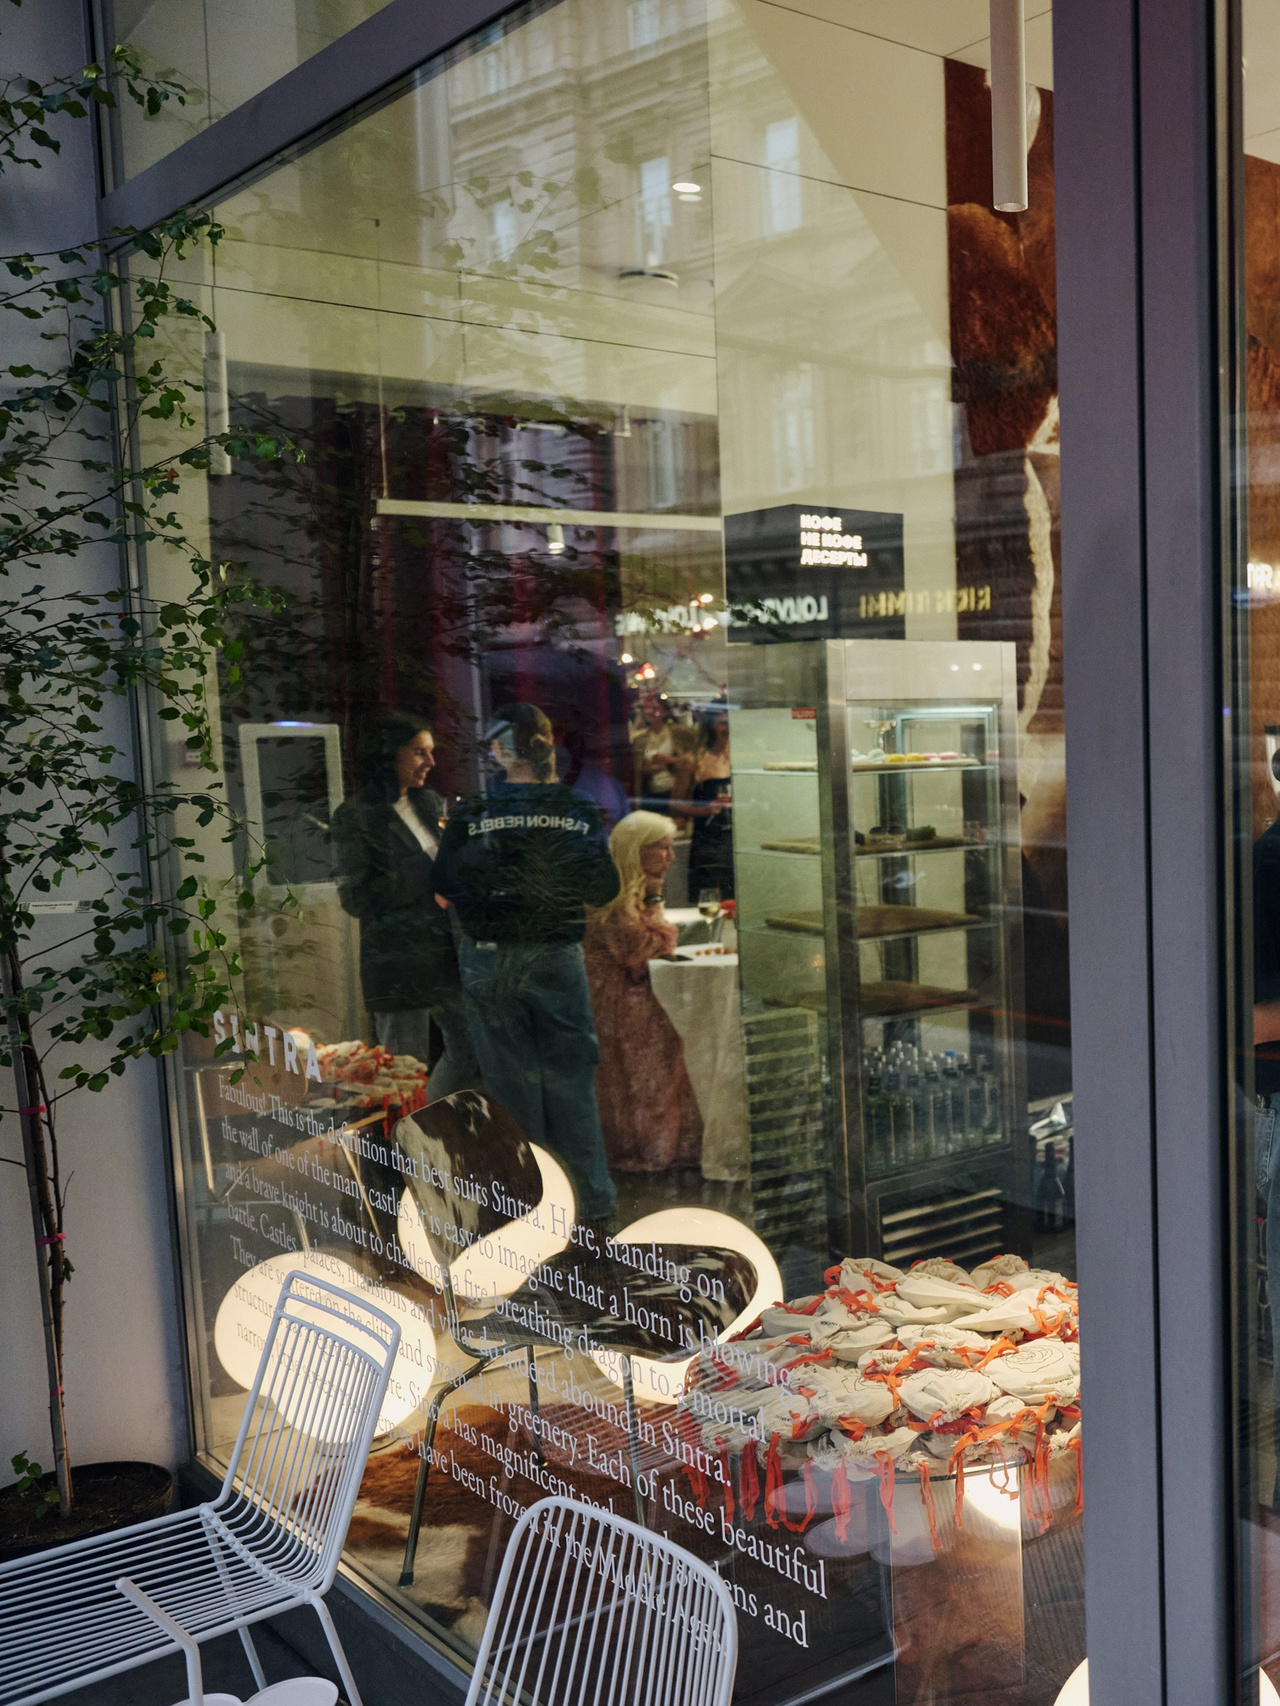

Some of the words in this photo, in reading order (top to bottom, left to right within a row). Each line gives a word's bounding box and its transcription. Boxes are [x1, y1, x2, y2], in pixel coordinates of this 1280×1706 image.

[800, 548, 867, 567] ДЕСЕРТЫ
[213, 1010, 323, 1083] SINTRA
[218, 1074, 267, 1116] Fabulous!
[268, 1093, 294, 1129] This
[295, 1110, 305, 1131] is
[306, 1112, 325, 1142] the
[327, 1117, 389, 1166] definition
[390, 1149, 418, 1177] that
[420, 1151, 450, 1192] best
[453, 1174, 488, 1207] suits
[491, 1180, 545, 1230] Sintra.
[550, 1203, 601, 1259] Here,
[605, 1236, 692, 1304] standing
[697, 1273, 727, 1306] on
[221, 1115, 238, 1144] the
[238, 1125, 259, 1154] wall
[261, 1134, 274, 1158] of
[275, 1147, 295, 1173] one
[296, 1151, 310, 1177] of
[310, 1154, 330, 1186] the
[332, 1176, 367, 1210] many
[368, 1186, 414, 1229] castles,
[416, 1201, 428, 1227] it
[429, 1208, 441, 1236] is
[444, 1223, 474, 1260] easy
[477, 1233, 494, 1259] to
[497, 1236, 564, 1292] imagine
[567, 1265, 605, 1311] that
[609, 1293, 620, 1318] a
[623, 1287, 674, 1342] horn
[678, 1313, 695, 1352] is
[699, 1319, 794, 1408] blowing
[224, 1161, 244, 1187] and
[244, 1172, 251, 1190] a
[251, 1165, 280, 1203] brave
[281, 1185, 318, 1228] knight
[319, 1202, 330, 1229] is
[331, 1206, 367, 1250] about
[369, 1231, 384, 1256] to
[385, 1233, 449, 1296] challenge
[452, 1279, 461, 1300] a
[463, 1269, 489, 1309] fire
[492, 1282, 574, 1360] breathing
[577, 1323, 644, 1384] dragon
[649, 1365, 670, 1397] to
[676, 1382, 686, 1406] a
[692, 1389, 767, 1444] mortal
[227, 1198, 258, 1233] battle.
[260, 1213, 300, 1259] Castles,
[303, 1239, 345, 1283] palaces,
[347, 1265, 407, 1313] mansions
[410, 1298, 435, 1328] and
[438, 1307, 474, 1351] villas
[479, 1326, 498, 1360] do
[502, 1341, 556, 1393] indeed
[562, 1370, 632, 1433] abound
[637, 1409, 656, 1447] in
[662, 1420, 731, 1487] Sintra.
[229, 1234, 256, 1278] They
[258, 1259, 274, 1281] are
[275, 1268, 322, 1306] scttered
[398, 1339, 423, 1367] and
[427, 1355, 485, 1403] swathed
[488, 1381, 504, 1416] in
[508, 1401, 582, 1466] greenery.
[586, 1433, 632, 1488] Each
[636, 1468, 660, 1502] of
[662, 1479, 715, 1535] these
[720, 1505, 828, 1600] beautiful
[400, 1427, 414, 1451] to
[416, 1427, 449, 1474] have
[450, 1450, 486, 1499] been
[408, 1381, 450, 1430] Sintra
[453, 1411, 477, 1446] has
[481, 1432, 576, 1501] magnificent
[765, 1604, 809, 1649] and
